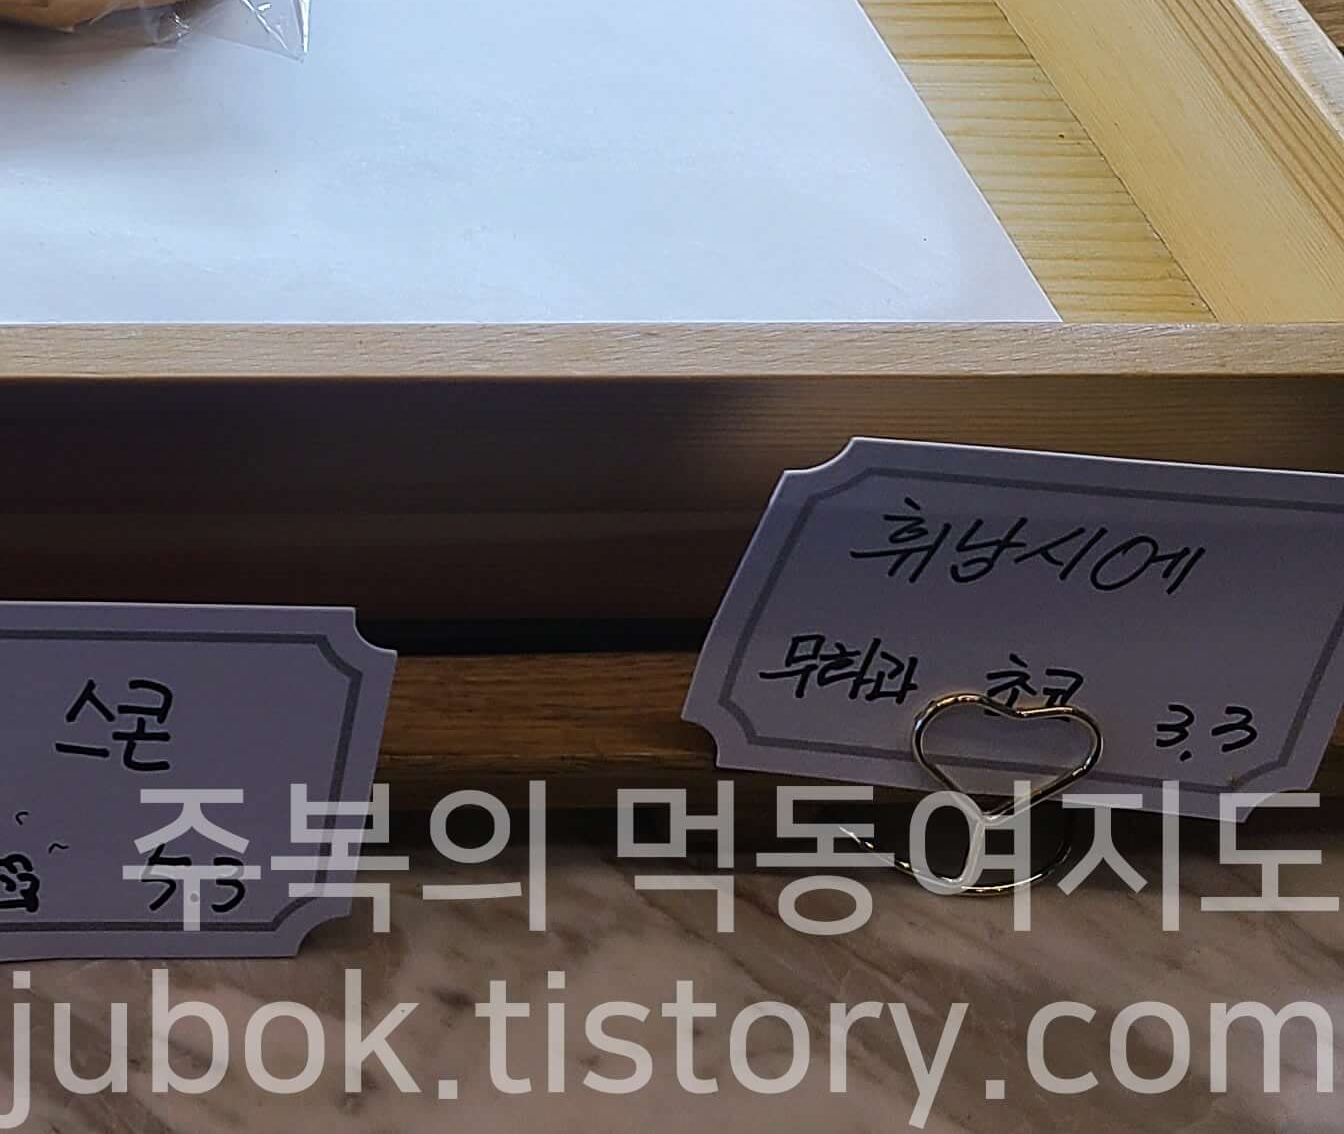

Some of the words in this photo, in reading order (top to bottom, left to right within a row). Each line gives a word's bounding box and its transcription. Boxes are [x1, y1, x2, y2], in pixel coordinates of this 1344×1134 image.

[850, 497, 1206, 594] 휘낭시에
[54, 677, 176, 773] 스콘
[1154, 702, 1259, 762] 3.3
